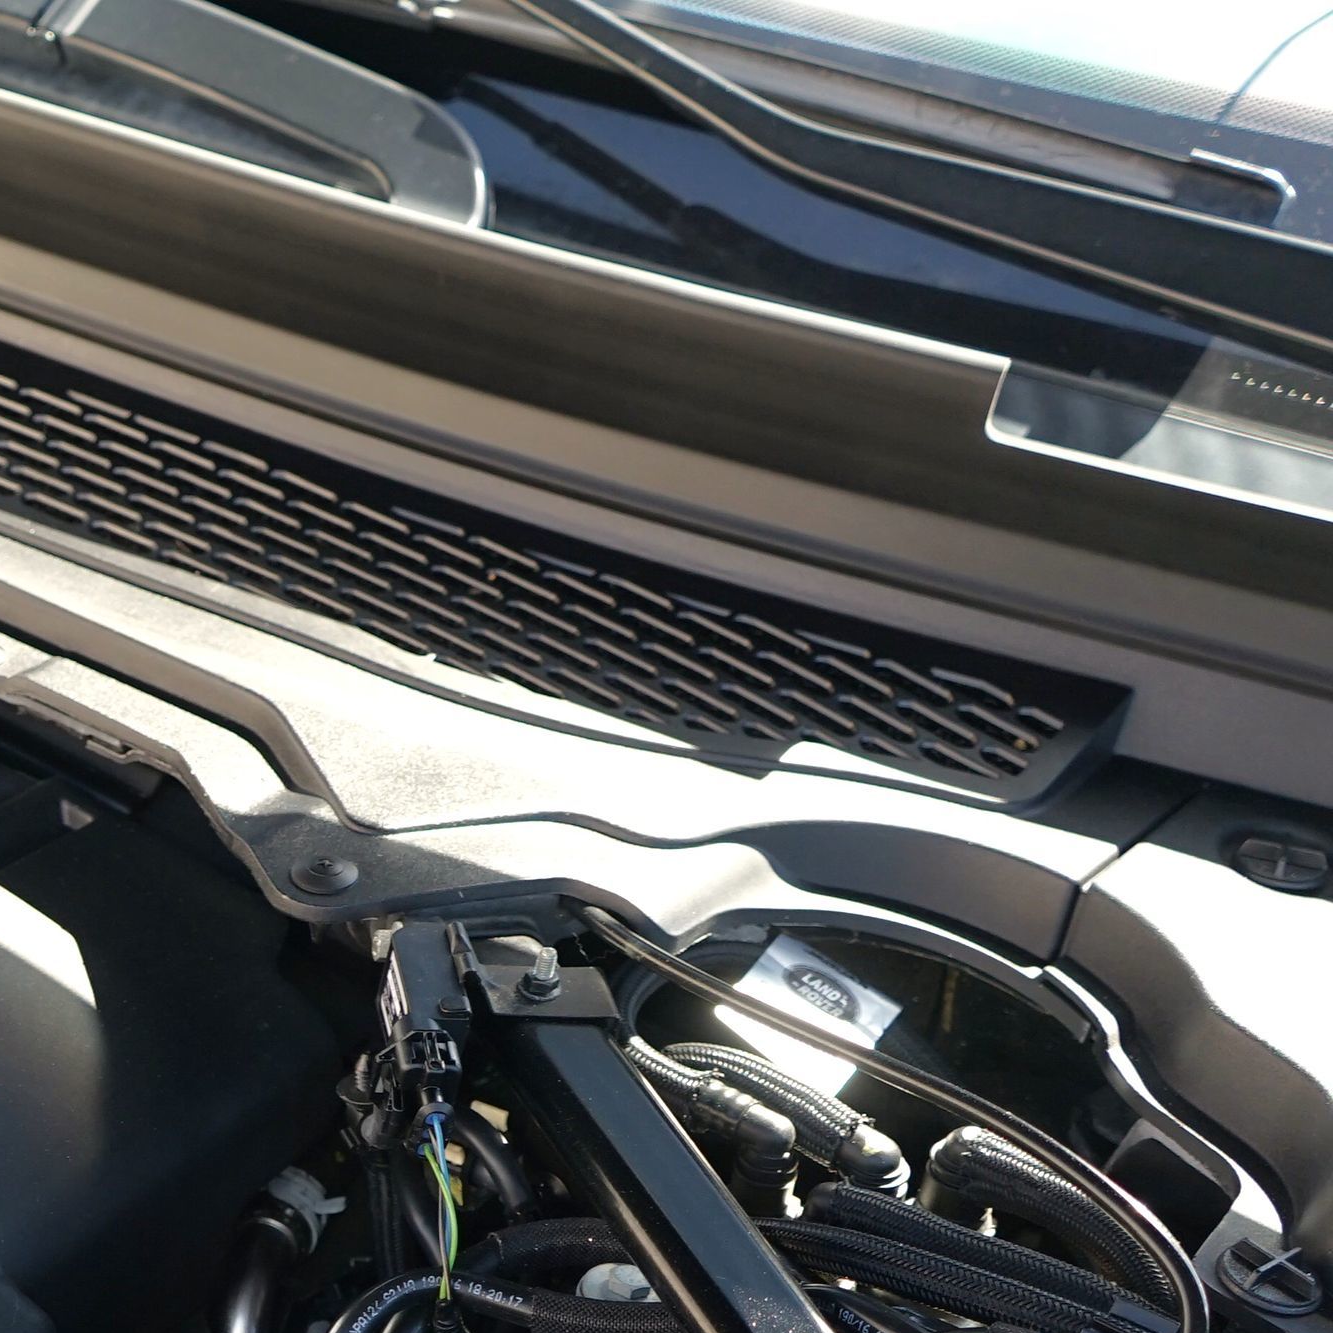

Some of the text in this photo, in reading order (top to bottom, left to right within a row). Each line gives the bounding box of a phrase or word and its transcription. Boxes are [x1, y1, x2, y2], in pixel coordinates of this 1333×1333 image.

[797, 985, 844, 1017] ROVER
[801, 973, 842, 1001] LAND
[468, 1281, 524, 1308] 18:20:17
